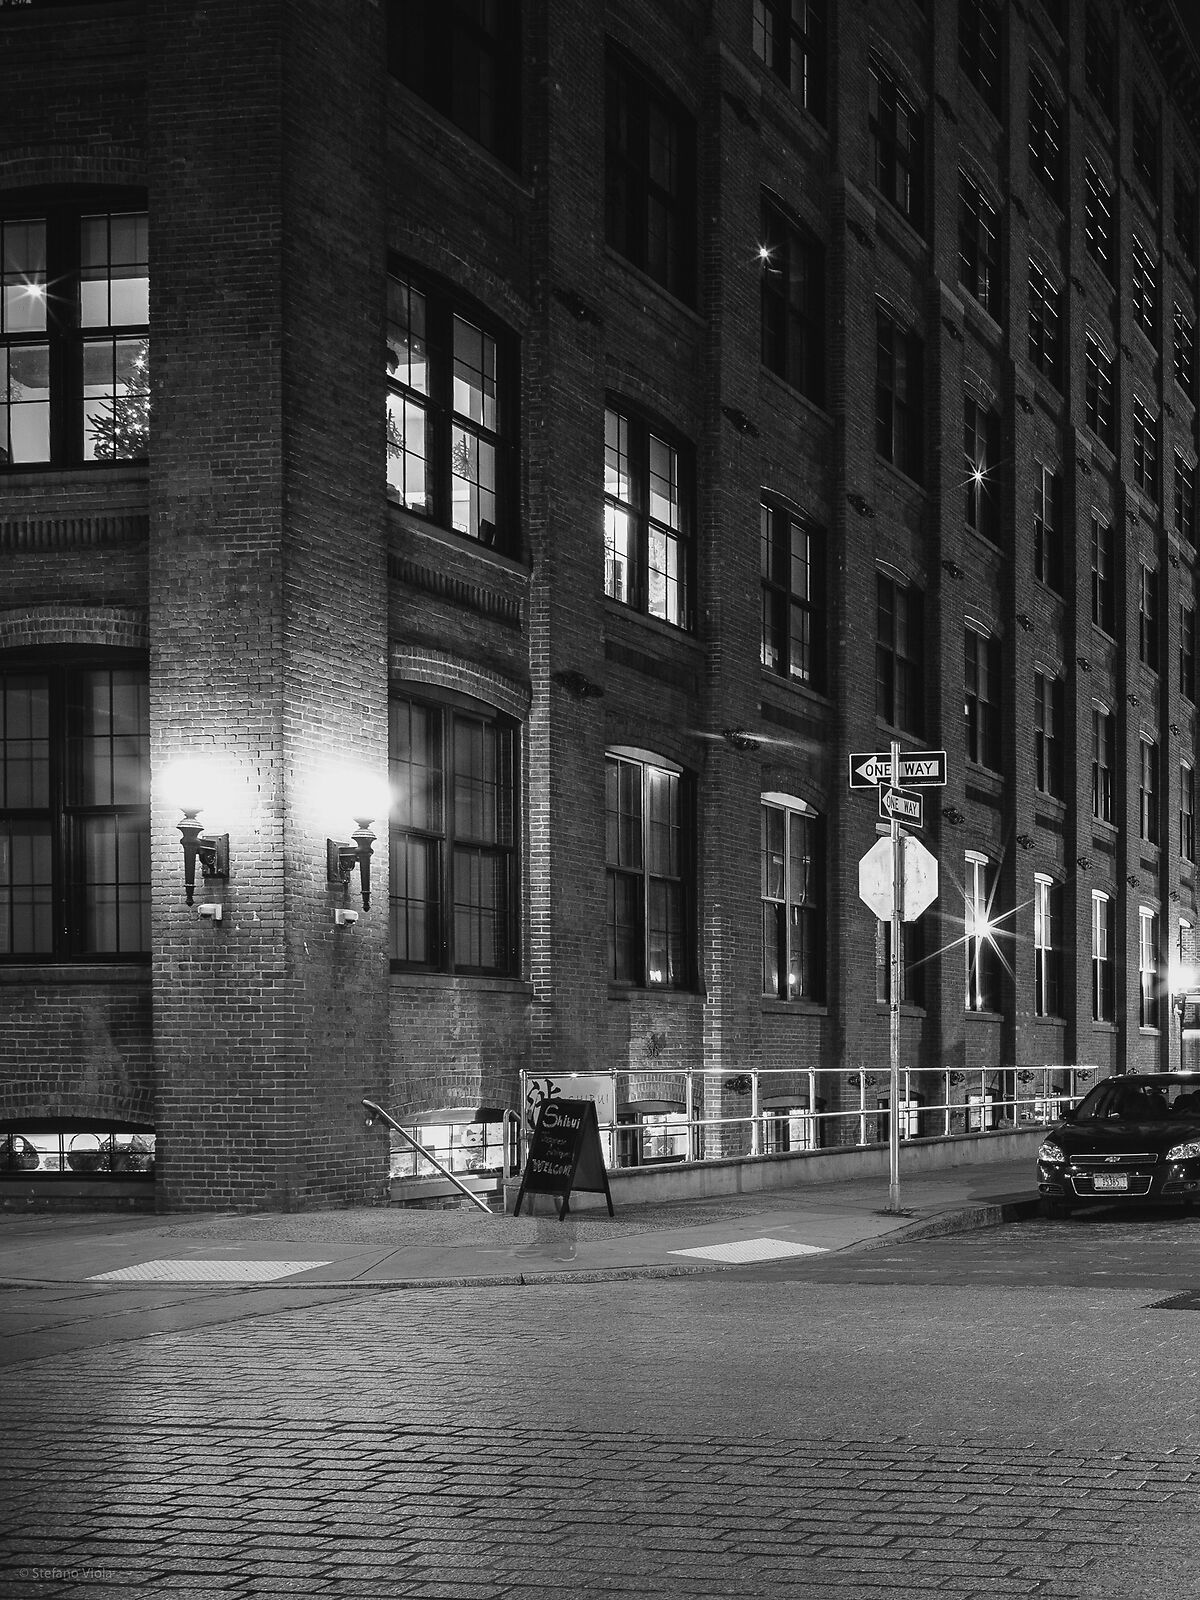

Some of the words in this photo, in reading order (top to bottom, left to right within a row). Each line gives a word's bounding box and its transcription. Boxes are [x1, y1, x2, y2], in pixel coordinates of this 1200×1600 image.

[865, 762, 891, 776] ONE
[905, 763, 933, 775] WAY
[886, 795, 899, 810] ONE
[904, 800, 917, 815] WAY
[542, 1103, 581, 1129] Shibui
